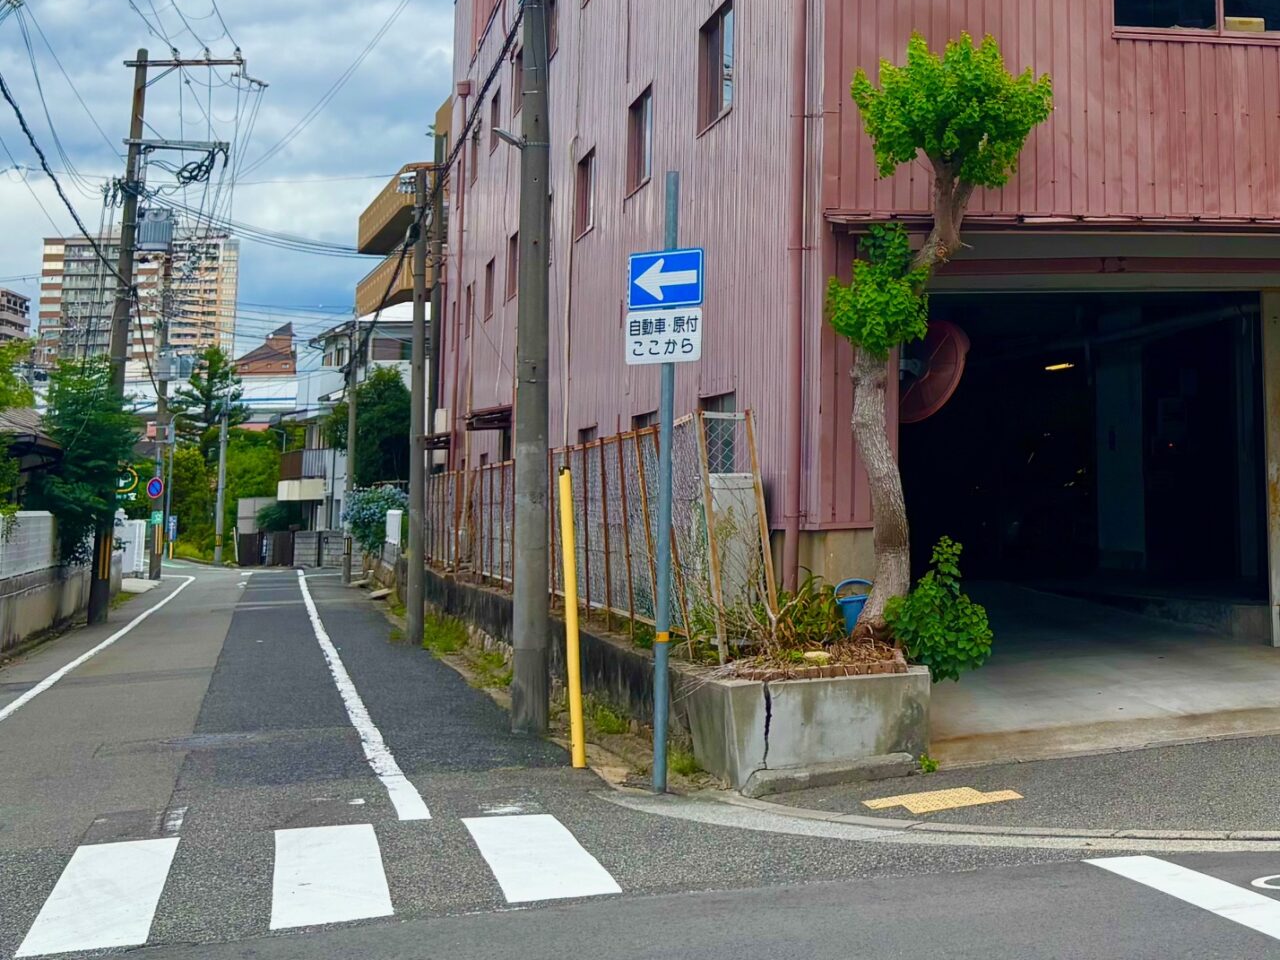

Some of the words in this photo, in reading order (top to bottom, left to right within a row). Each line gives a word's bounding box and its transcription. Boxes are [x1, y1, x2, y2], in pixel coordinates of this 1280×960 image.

[629, 315, 698, 336] 自動車・原付
[633, 338, 693, 356] ここから
